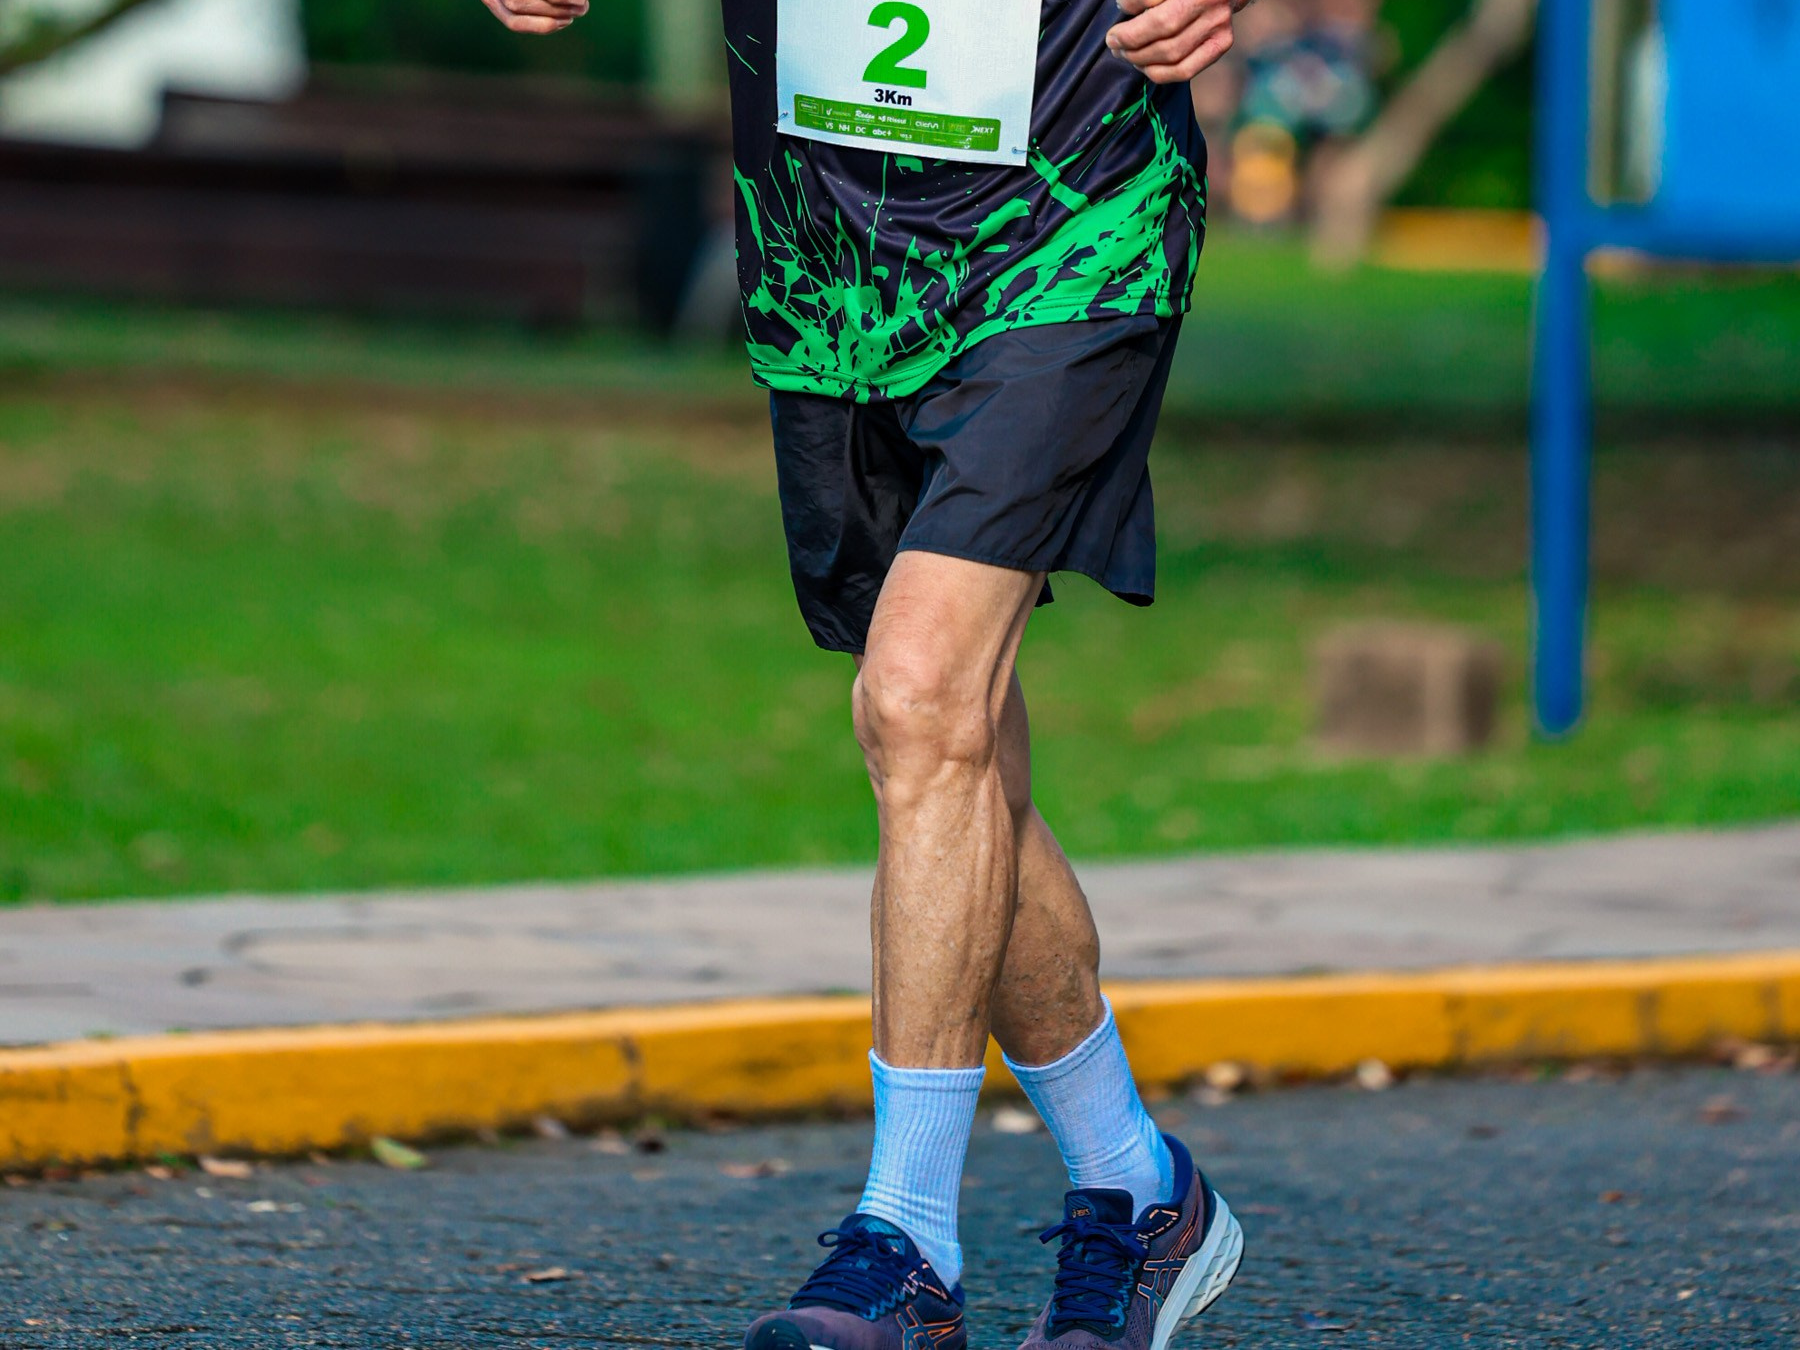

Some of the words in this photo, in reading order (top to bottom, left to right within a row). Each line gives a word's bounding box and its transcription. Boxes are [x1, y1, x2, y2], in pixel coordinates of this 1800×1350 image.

[862, 1, 931, 89] 2
[874, 88, 913, 106] 3Km
[838, 123, 850, 132] NH
[855, 126, 866, 134] DC
